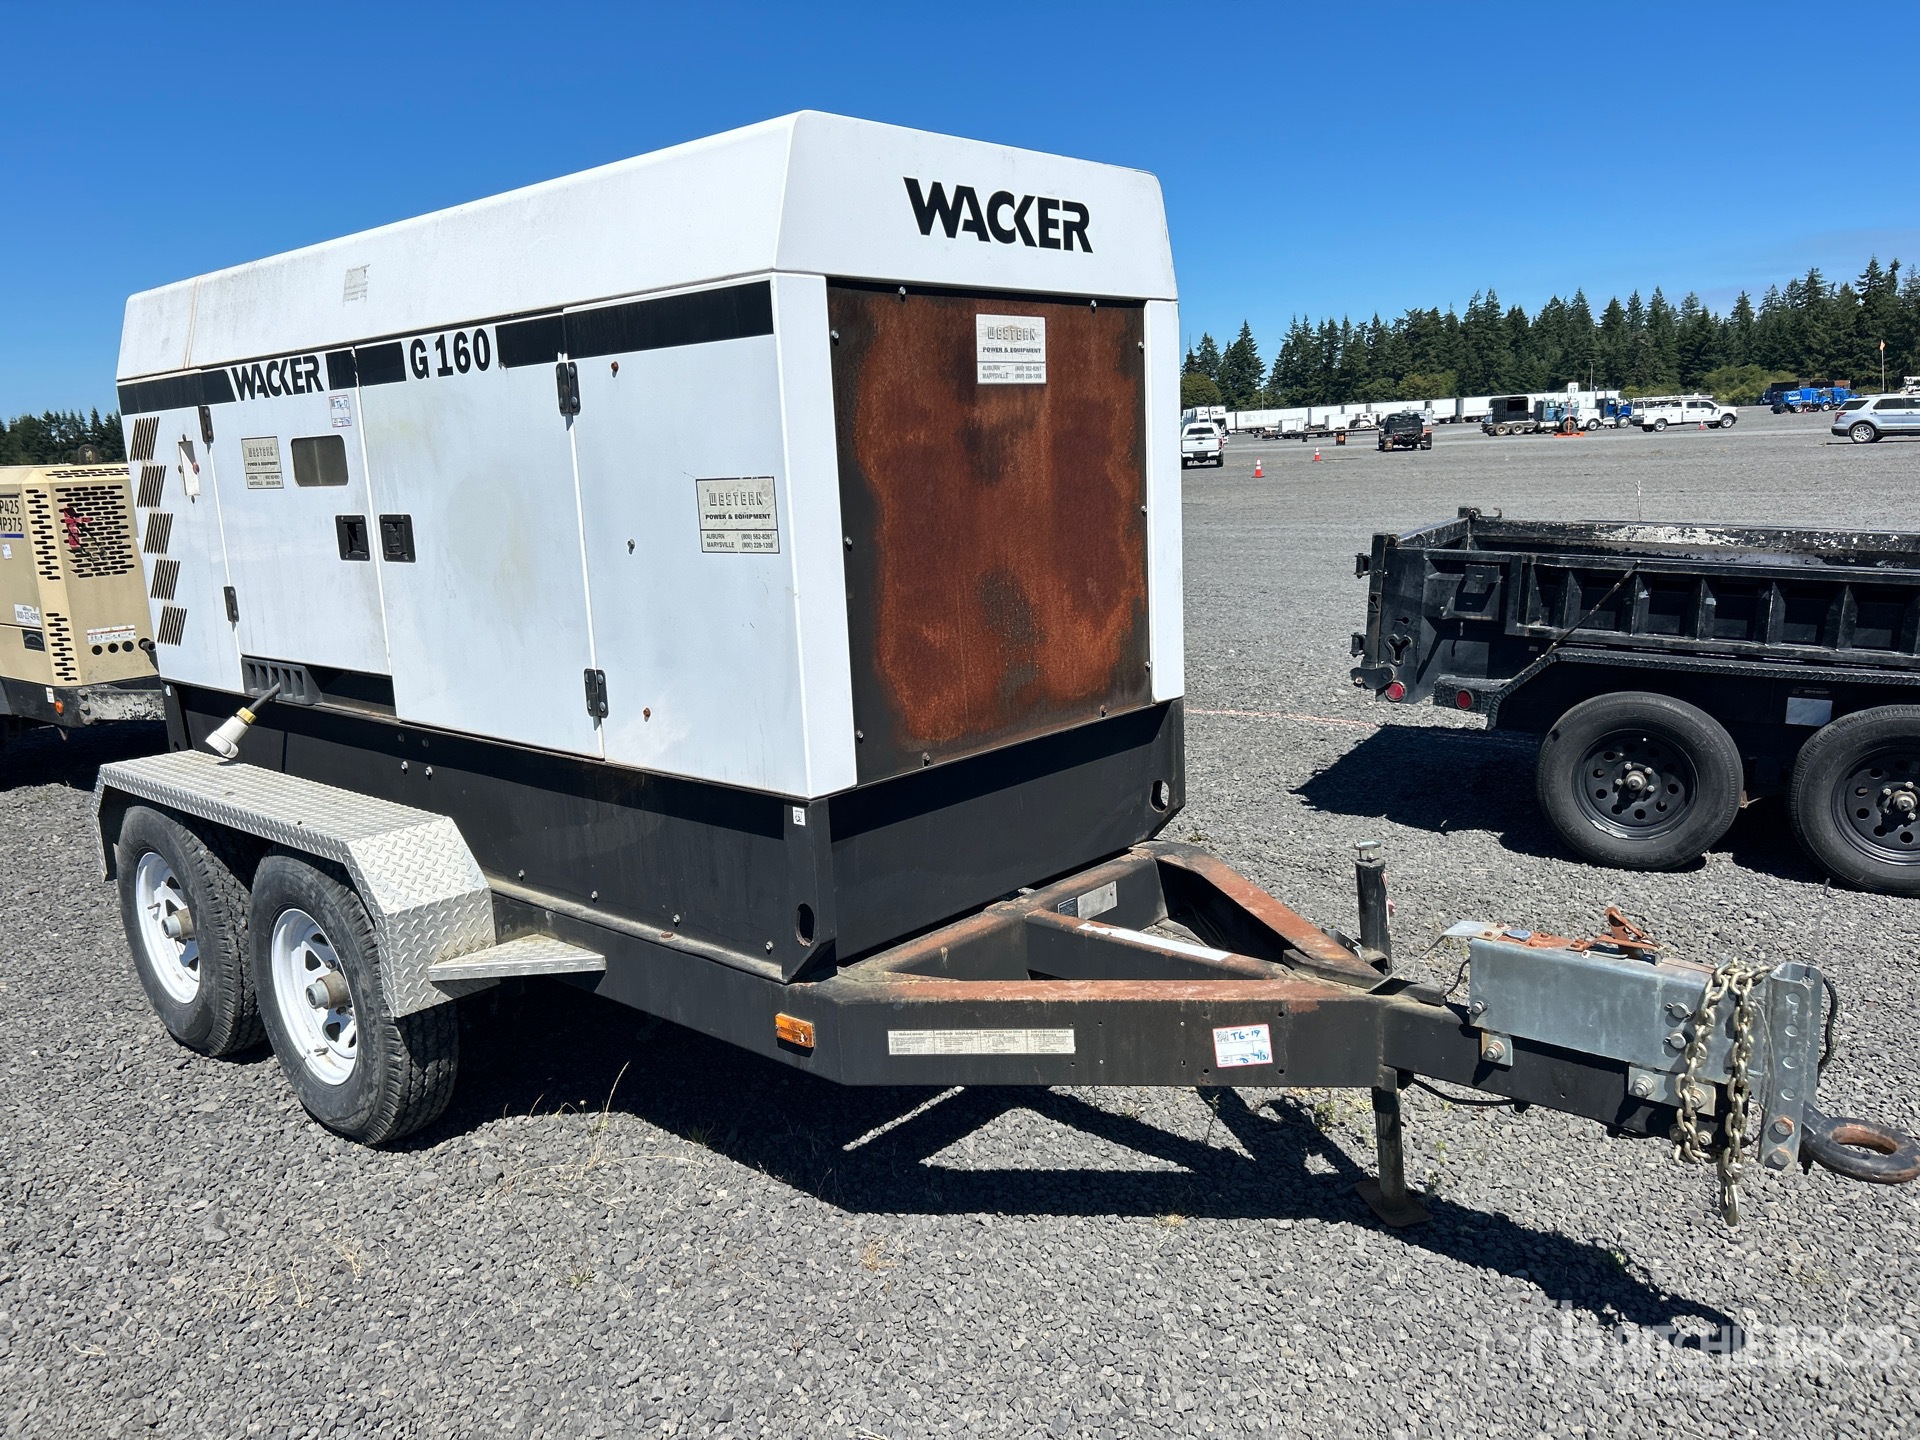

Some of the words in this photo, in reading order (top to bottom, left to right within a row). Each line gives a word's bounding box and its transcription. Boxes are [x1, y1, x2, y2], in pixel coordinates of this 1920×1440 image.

[903, 177, 1093, 253] WACKER
[987, 326, 1035, 340] WESTERN
[231, 354, 324, 401] WACKER
[709, 491, 763, 506] WESTERN
[741, 533, 752, 541] (800)
